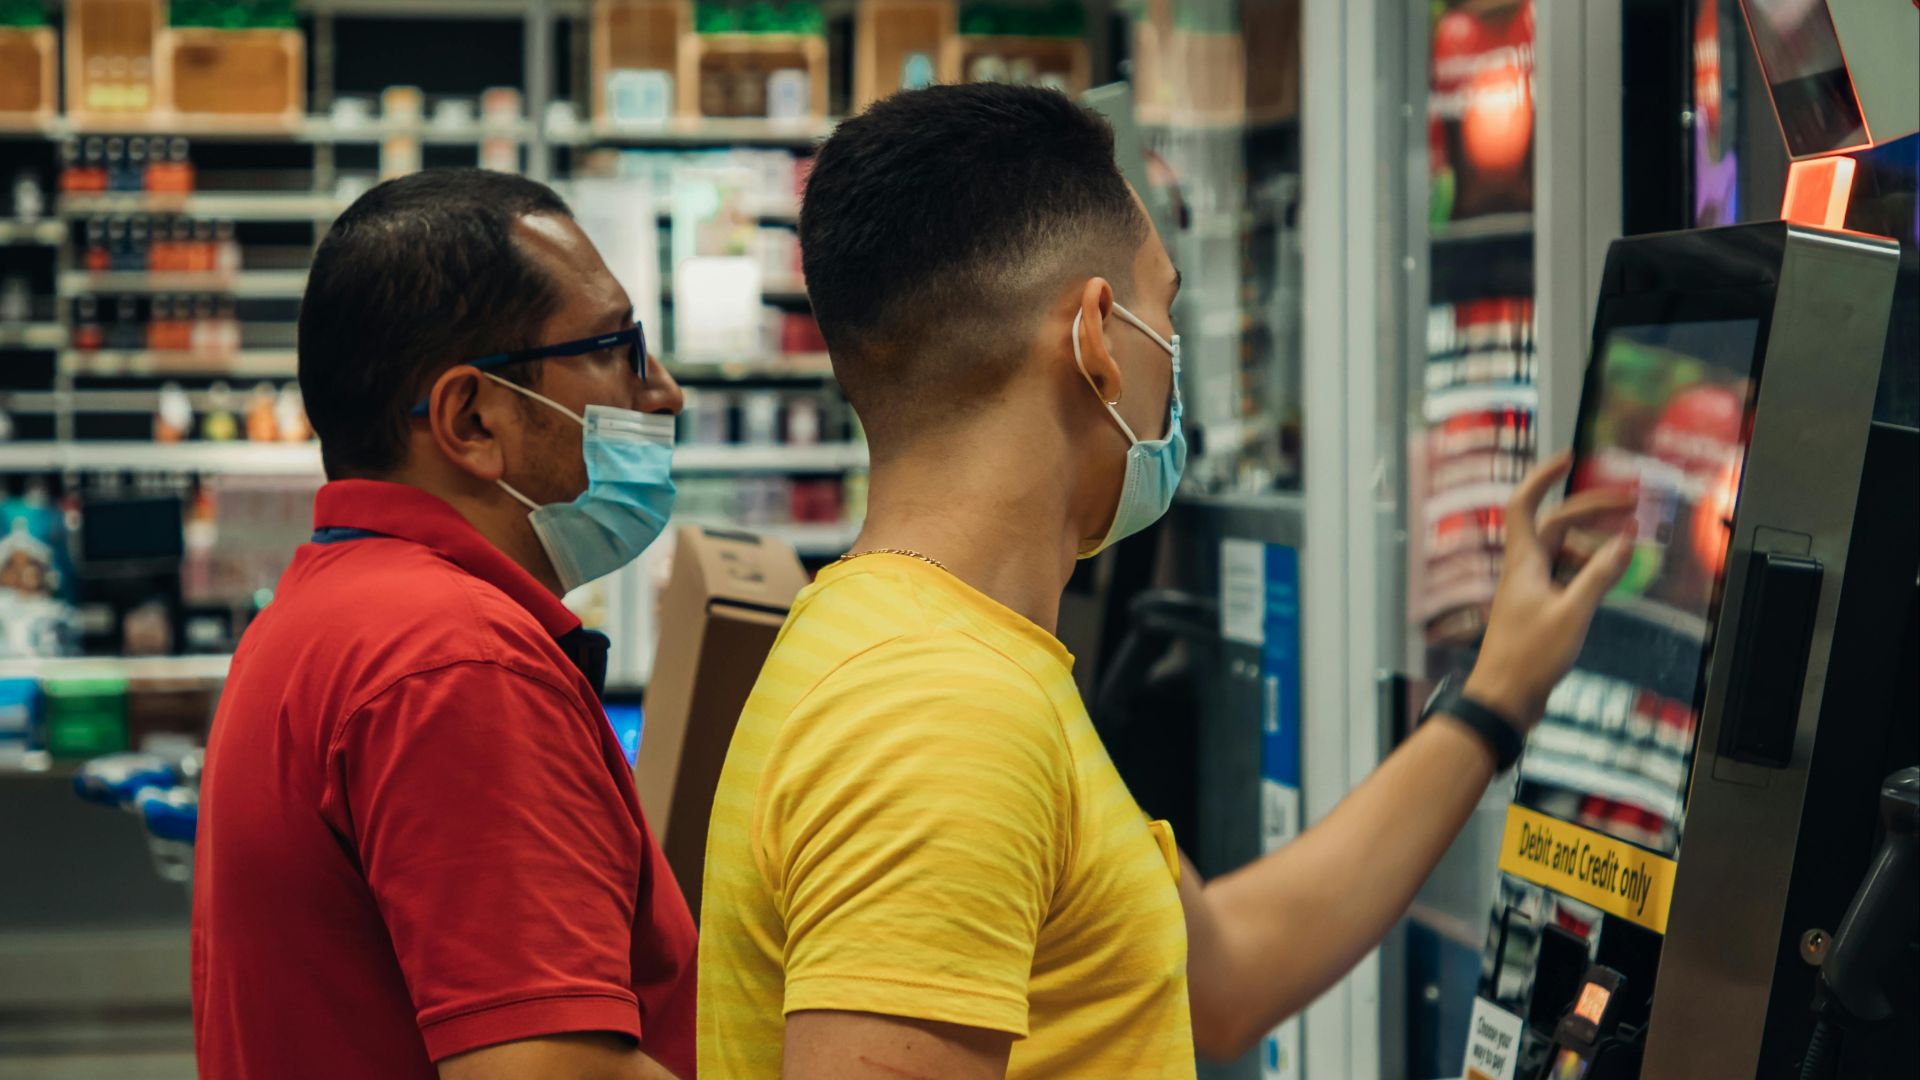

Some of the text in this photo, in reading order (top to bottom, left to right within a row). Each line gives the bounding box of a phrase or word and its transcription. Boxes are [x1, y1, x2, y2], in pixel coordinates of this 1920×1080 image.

[1519, 821, 1652, 917] Debit and Credit only
[1485, 1048, 1493, 1065] to
